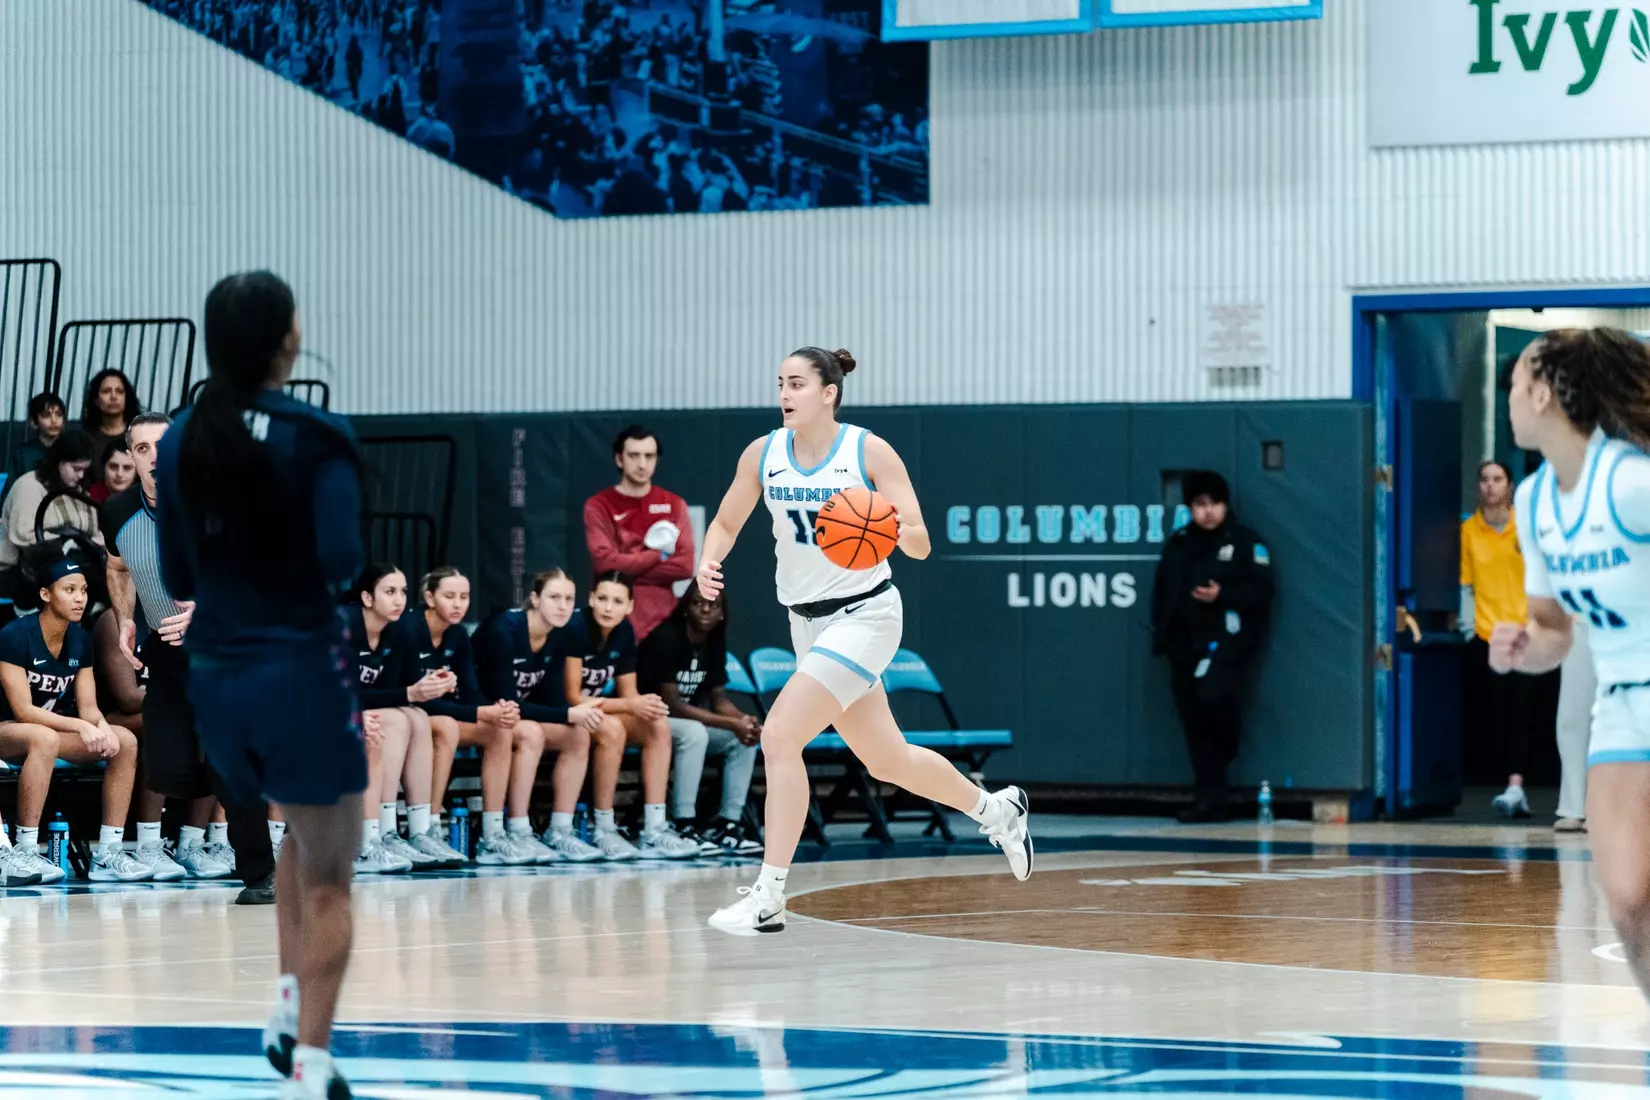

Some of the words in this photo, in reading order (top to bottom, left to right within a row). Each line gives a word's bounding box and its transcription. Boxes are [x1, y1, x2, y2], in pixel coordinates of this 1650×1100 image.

[1468, 0, 1620, 96] Ivy
[768, 485, 852, 503] COLUMB
[1007, 572, 1138, 608] LIONS
[27, 670, 75, 693] PEN
[53, 832, 61, 868] OWERADE
